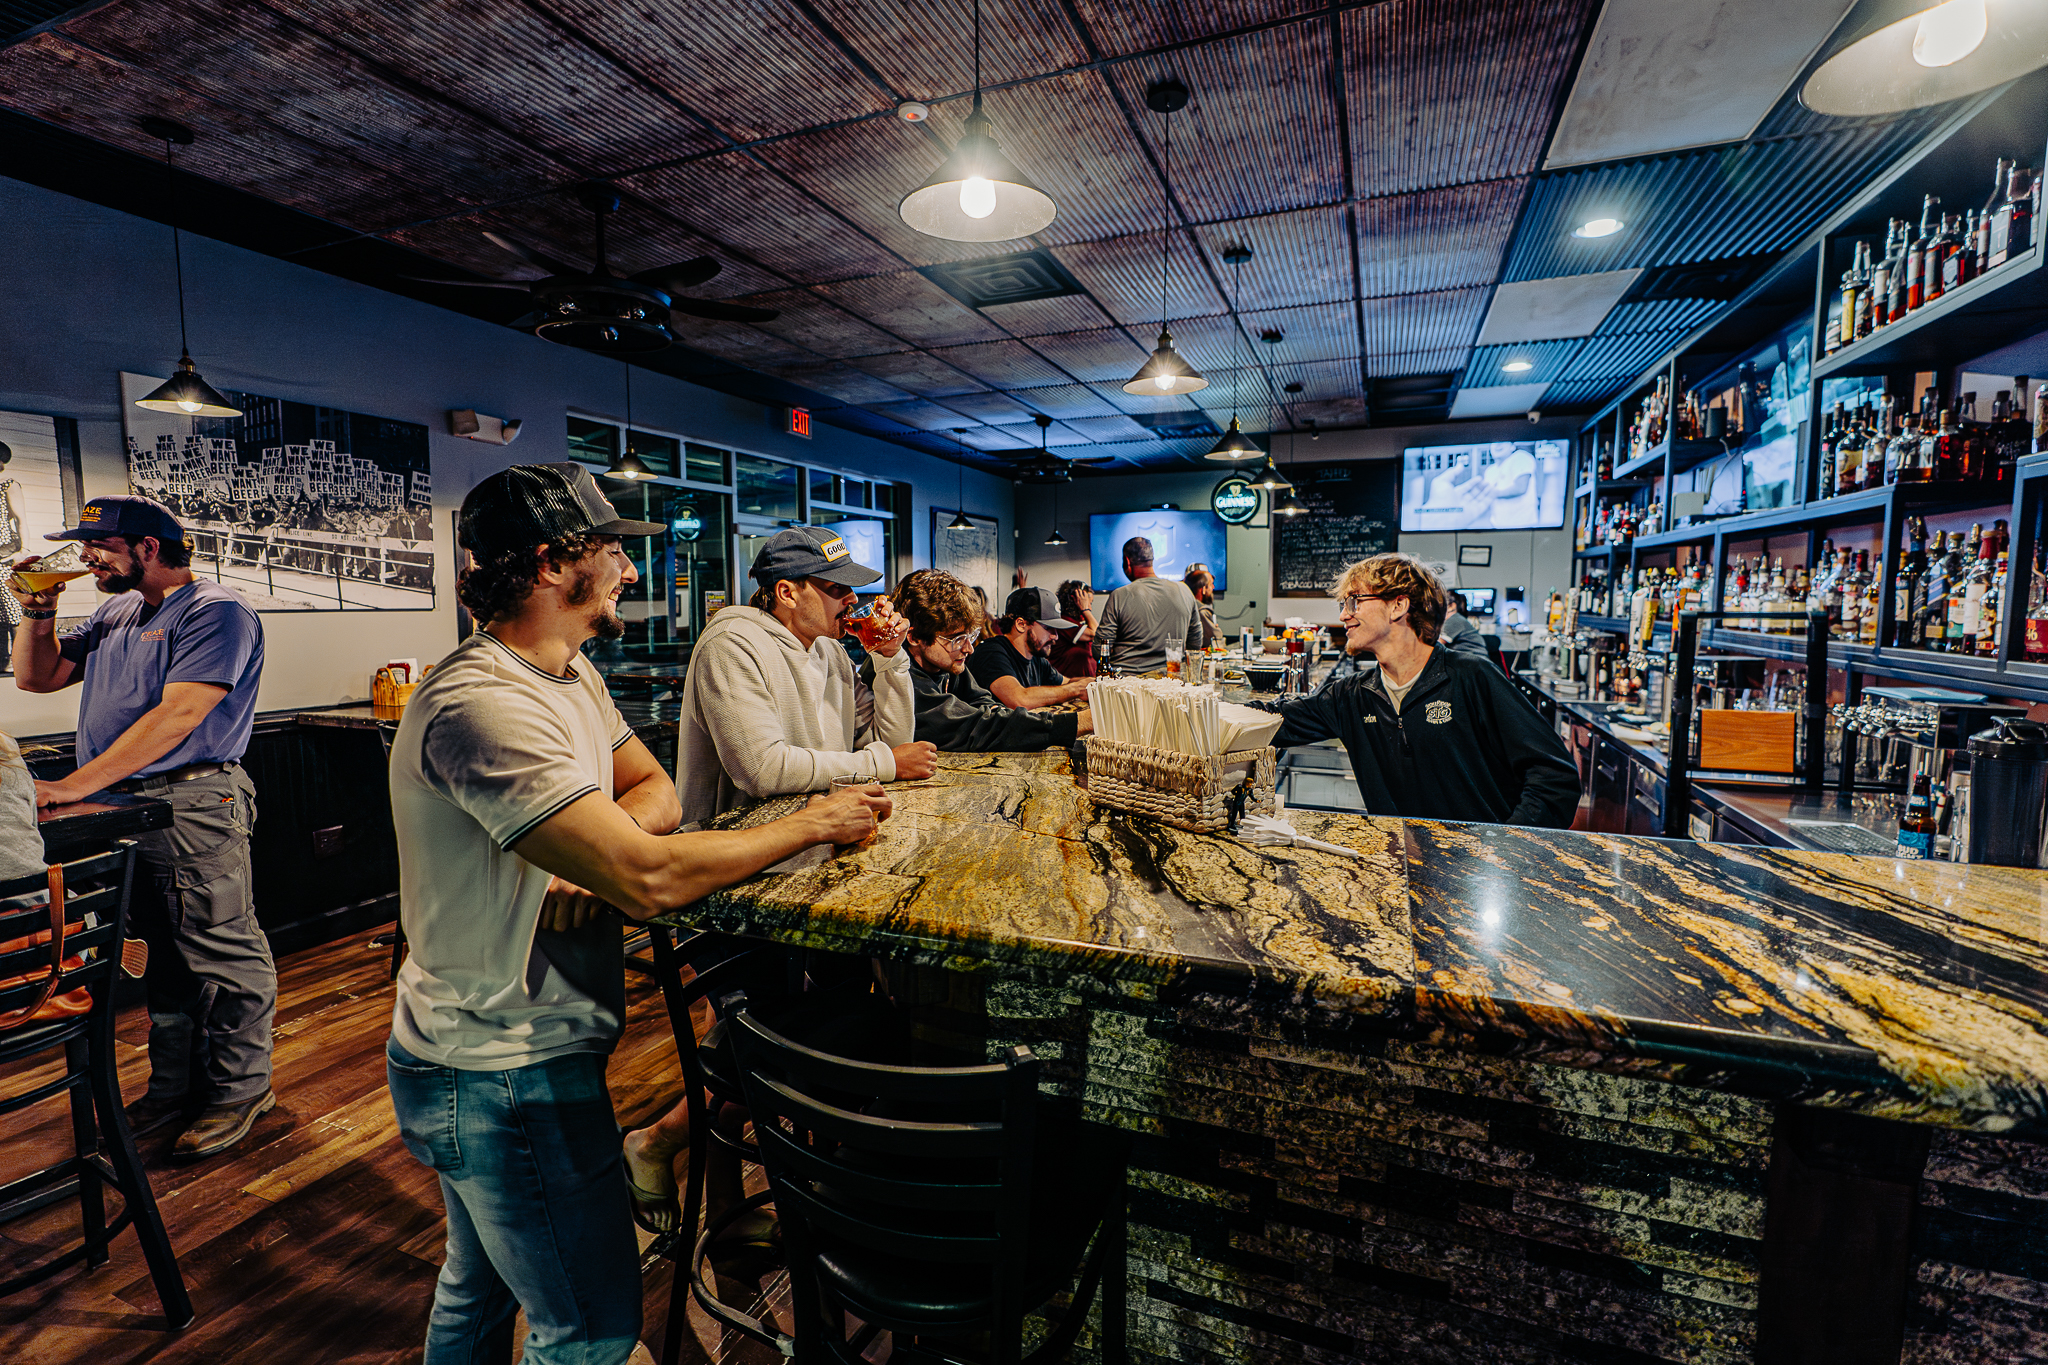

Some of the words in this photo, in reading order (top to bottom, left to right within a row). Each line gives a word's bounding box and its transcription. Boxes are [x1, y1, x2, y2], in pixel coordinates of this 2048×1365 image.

[792, 409, 809, 435] EXIT
[211, 439, 233, 449] WE
[314, 440, 333, 450] WE
[181, 447, 201, 459] WE
[289, 446, 308, 455] WE
[134, 451, 154, 461] WE
[209, 450, 236, 462] WANT
[309, 460, 330, 471] WE
[232, 469, 254, 478] WE
[308, 471, 332, 482] WANT
[381, 473, 400, 484] WE
[231, 478, 258, 488] WANT
[309, 483, 334, 492] BEER
[233, 489, 259, 499] BEER
[380, 483, 402, 495] WANT
[380, 495, 403, 505] BEER
[1216, 496, 1256, 508] GUINNESS
[1280, 580, 1313, 590] TOBACCO
